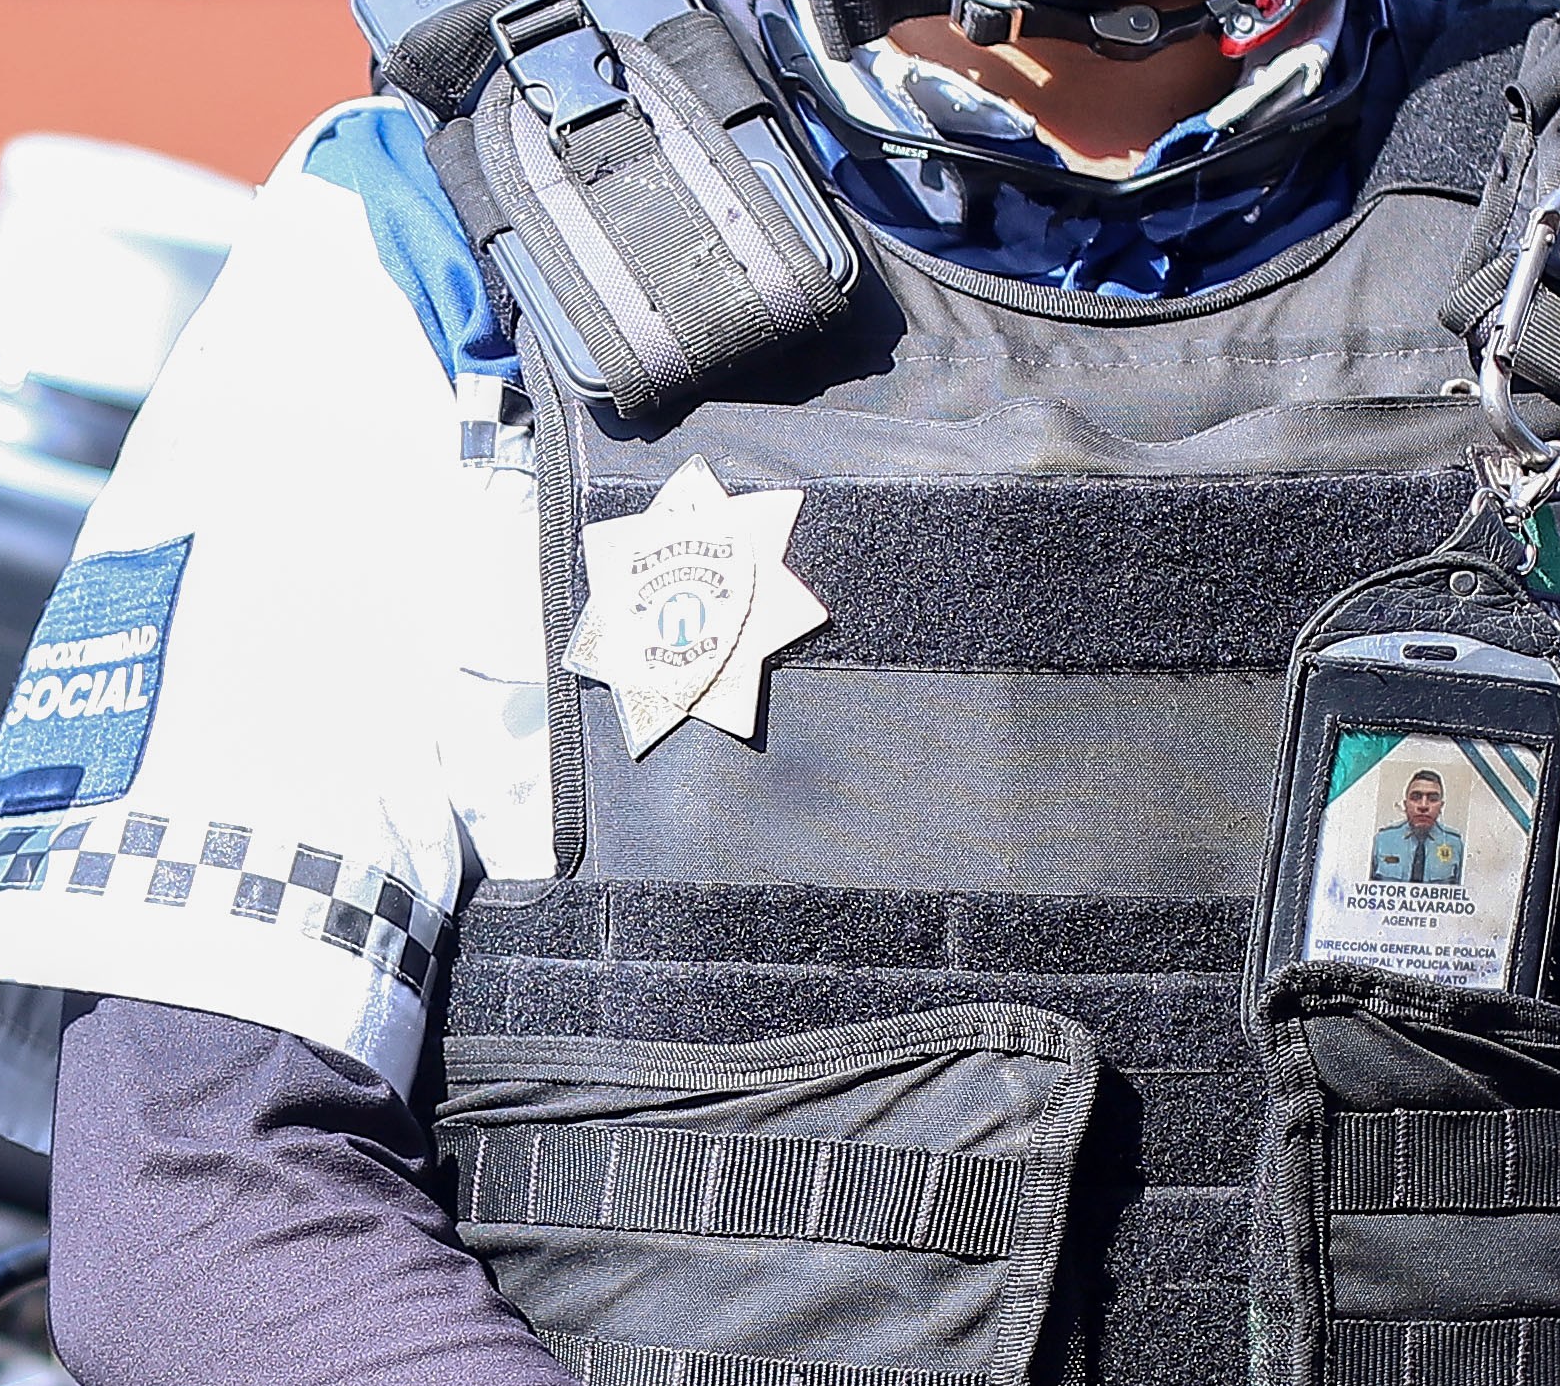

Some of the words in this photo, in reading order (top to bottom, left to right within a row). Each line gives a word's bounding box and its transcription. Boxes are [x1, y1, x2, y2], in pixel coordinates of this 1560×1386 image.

[882, 141, 928, 160] NEMESIS
[639, 566, 724, 601] MUNICIPAL
[6, 663, 149, 726] SOCIAL
[1355, 883, 1406, 898] VICTOR
[1410, 886, 1470, 901] GABRIEL
[1347, 896, 1396, 911] ROSAS
[1398, 899, 1476, 915] ALVARADO
[1381, 915, 1427, 927] AGENTE
[1429, 917, 1437, 928] B
[1315, 939, 1378, 953] DIRECCIÓN
[1380, 943, 1432, 956] GENERAL
[1435, 946, 1451, 957] DE
[1396, 958, 1404, 969] Y
[1452, 959, 1478, 972] VIAL
